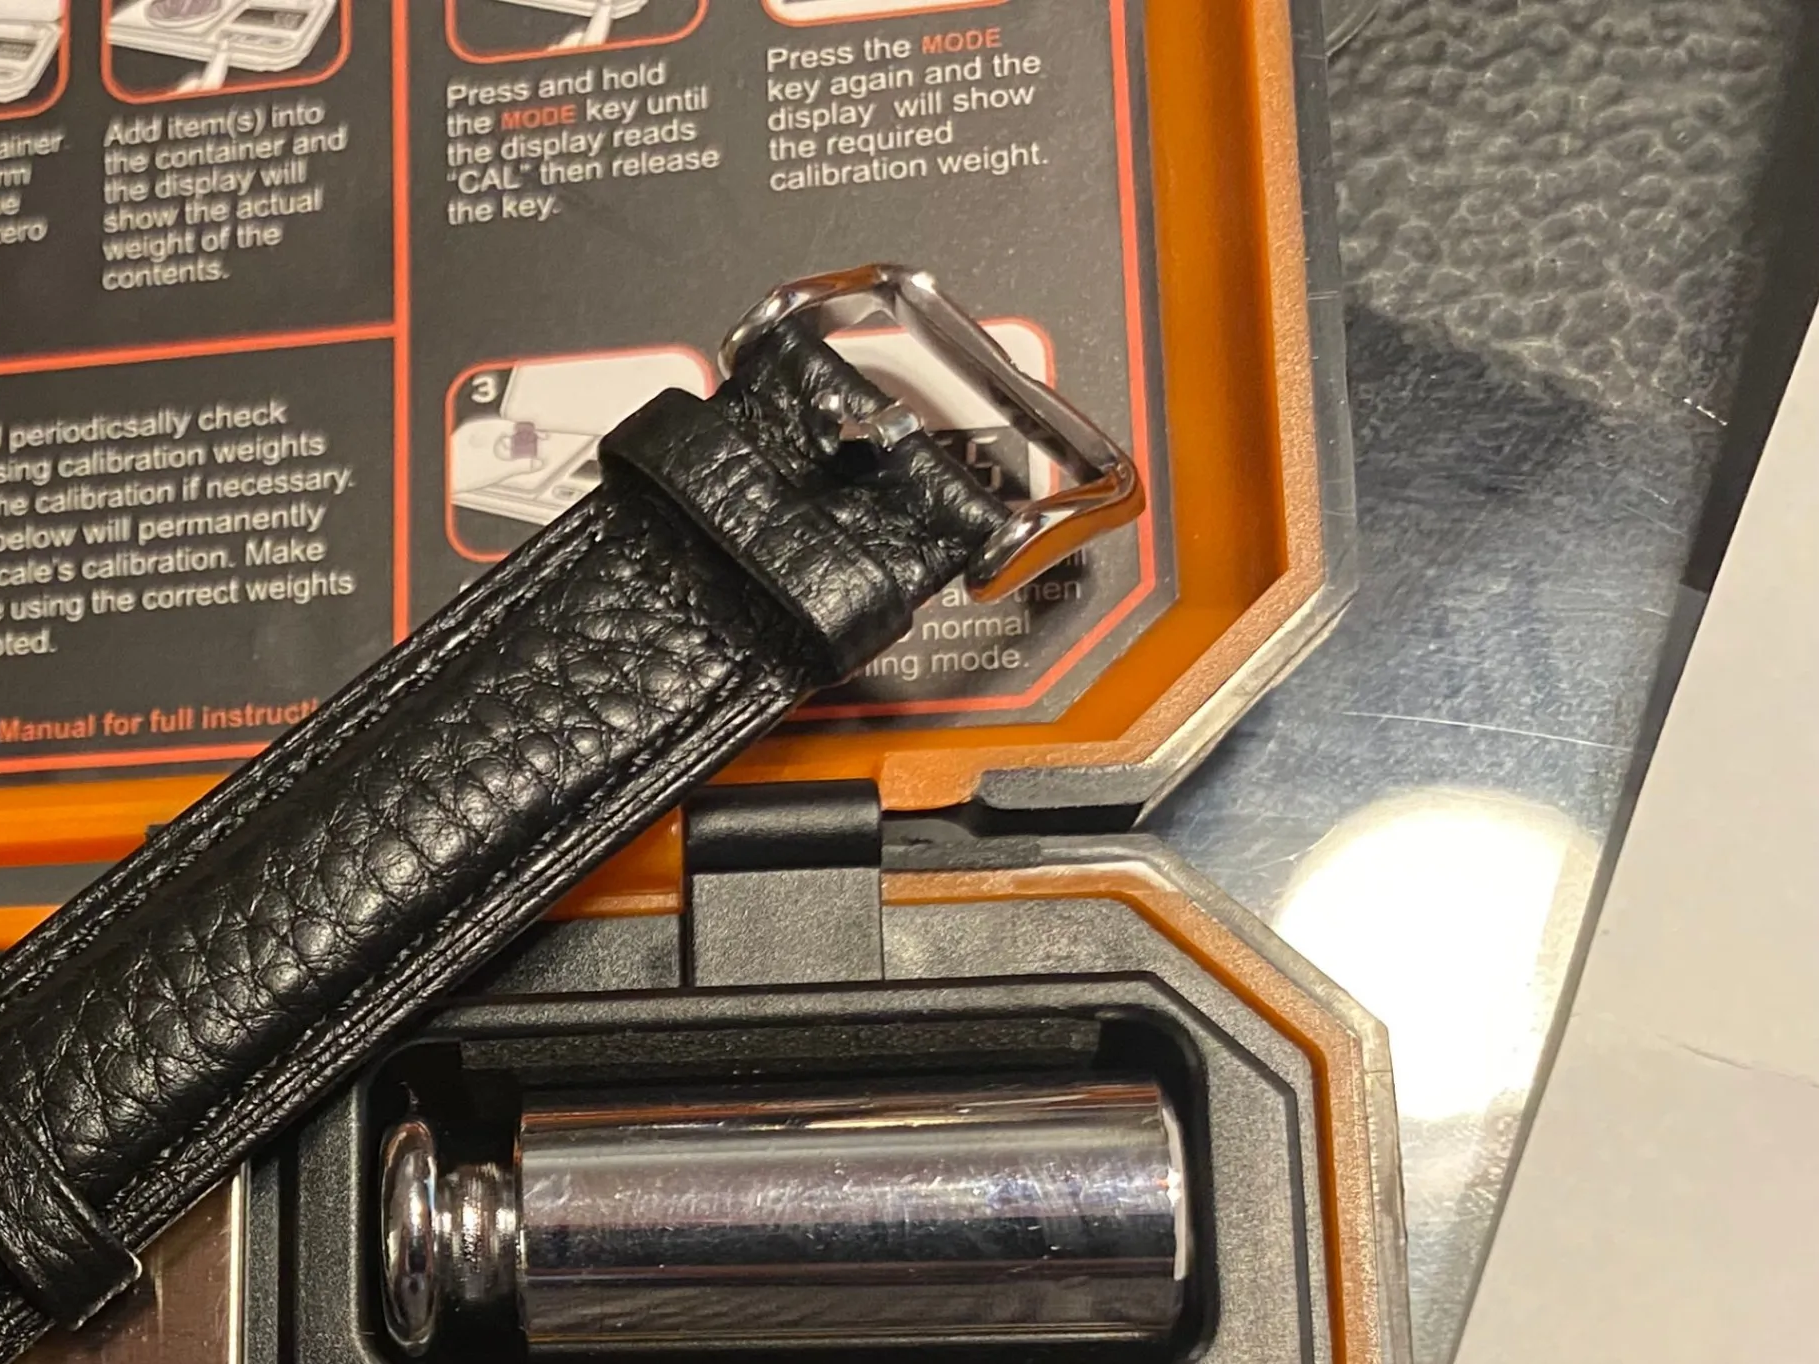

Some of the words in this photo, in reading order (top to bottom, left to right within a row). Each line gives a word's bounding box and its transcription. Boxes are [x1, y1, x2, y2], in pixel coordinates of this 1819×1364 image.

[767, 44, 856, 74] Press
[863, 33, 913, 63] the
[921, 20, 1003, 56] MODE
[446, 81, 531, 110] Press
[538, 67, 595, 99] and
[602, 59, 667, 92] hold
[767, 76, 821, 106] key
[829, 64, 915, 101] again
[924, 54, 983, 86] and
[992, 49, 1045, 78] the
[104, 117, 162, 148] Add
[168, 106, 265, 141] item(s)
[271, 103, 325, 129] into
[447, 110, 493, 138] the
[501, 99, 576, 132] MODE
[586, 96, 639, 126] key
[646, 84, 709, 116] until
[767, 100, 877, 134] display
[893, 89, 943, 119] will
[952, 84, 1037, 113] show
[104, 149, 149, 177] the
[155, 137, 285, 171] container
[292, 125, 347, 156] and
[447, 139, 493, 168] the
[500, 129, 605, 163] display
[613, 117, 698, 149] reads
[769, 134, 818, 162] the
[826, 118, 954, 159] required
[104, 177, 149, 205] the
[155, 168, 254, 202] display
[260, 159, 306, 189] will
[539, 159, 604, 186] then
[611, 149, 722, 178] release
[769, 154, 929, 192] calibration
[936, 140, 1050, 176] weight.
[104, 206, 178, 233] show
[185, 198, 230, 225] the
[236, 187, 323, 220] actual
[447, 199, 495, 226] the
[502, 194, 559, 222] key.
[103, 230, 195, 263] weight
[201, 225, 230, 252] of
[236, 222, 282, 249] the
[102, 258, 230, 292] contents.
[470, 376, 498, 404] 3
[198, 399, 287, 431] check
[58, 444, 206, 478] calibration
[213, 433, 326, 466] weights
[35, 480, 175, 515] calibration
[182, 475, 200, 502] if
[206, 469, 355, 500] necessary.
[83, 516, 131, 545] will
[138, 501, 326, 547] permanently
[82, 545, 233, 581] calibration.
[245, 536, 325, 568] Make
[11, 592, 84, 623] using
[91, 587, 135, 615] the
[142, 580, 239, 611] correct
[245, 571, 355, 605] weights
[921, 610, 1031, 641] normal
[931, 645, 1031, 674] mode.
[103, 711, 142, 737] for
[150, 705, 194, 734] full
